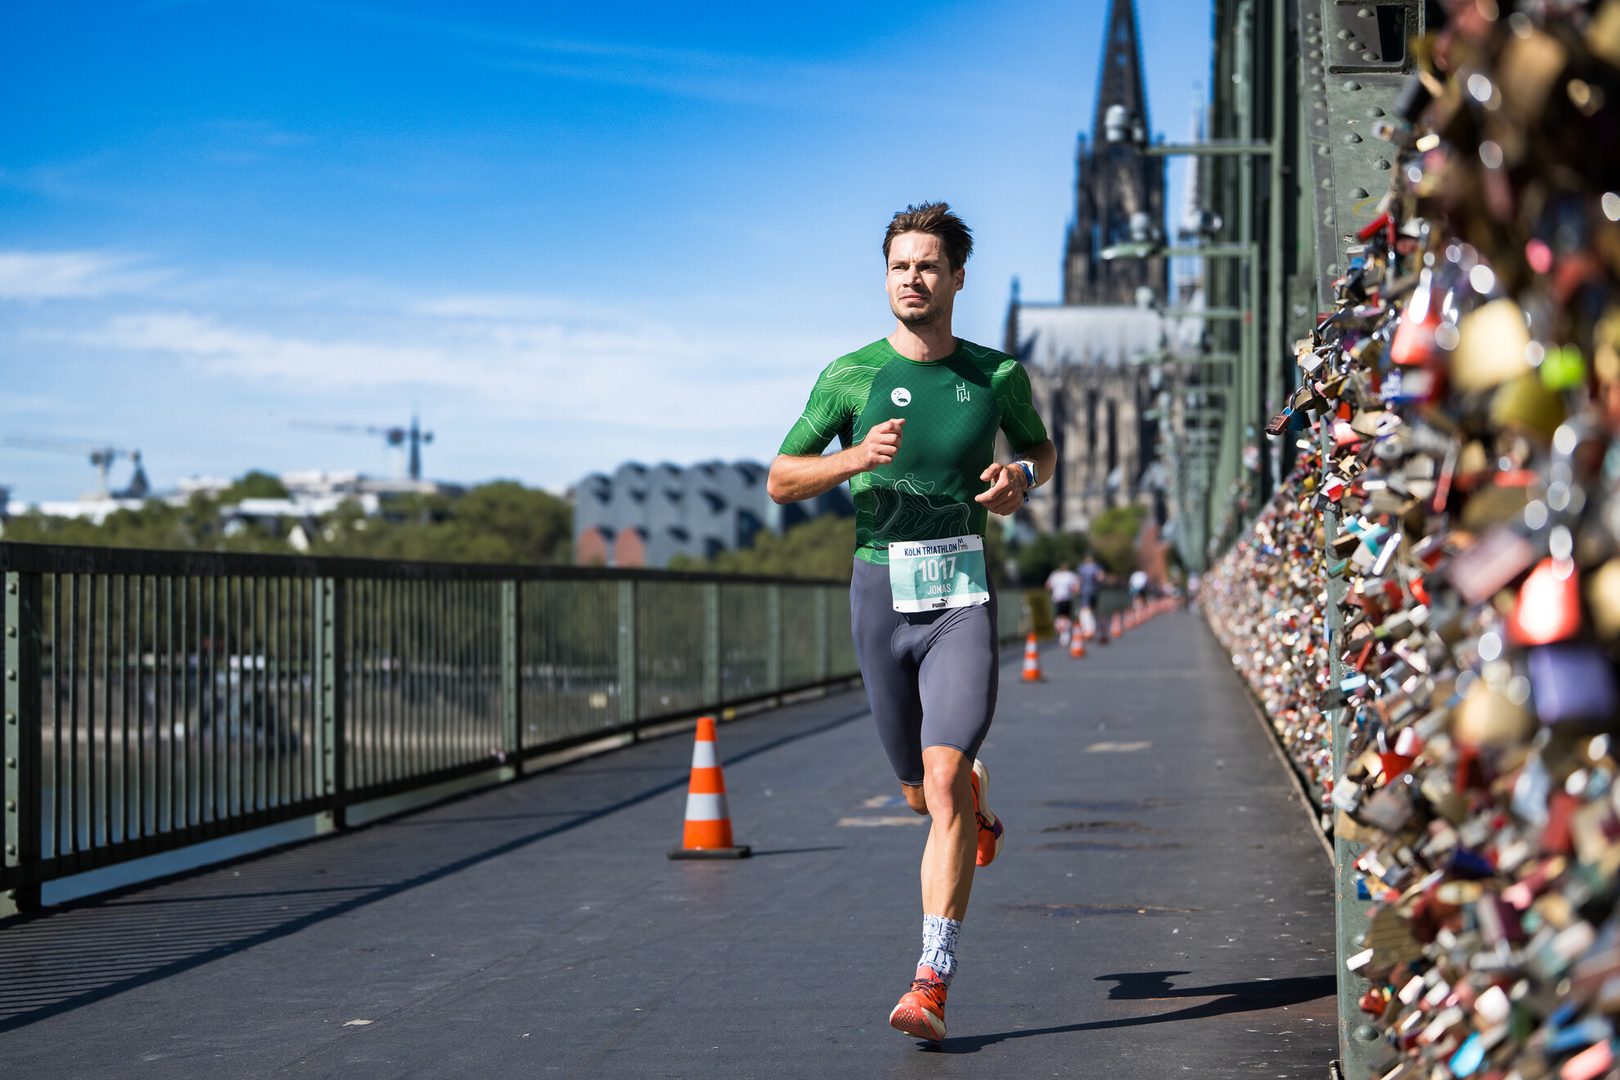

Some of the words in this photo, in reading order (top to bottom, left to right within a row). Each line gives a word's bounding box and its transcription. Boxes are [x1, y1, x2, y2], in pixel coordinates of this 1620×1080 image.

[922, 543, 958, 555] TRIATHLON
[918, 556, 957, 582] 1017
[927, 584, 951, 595] JONAS
